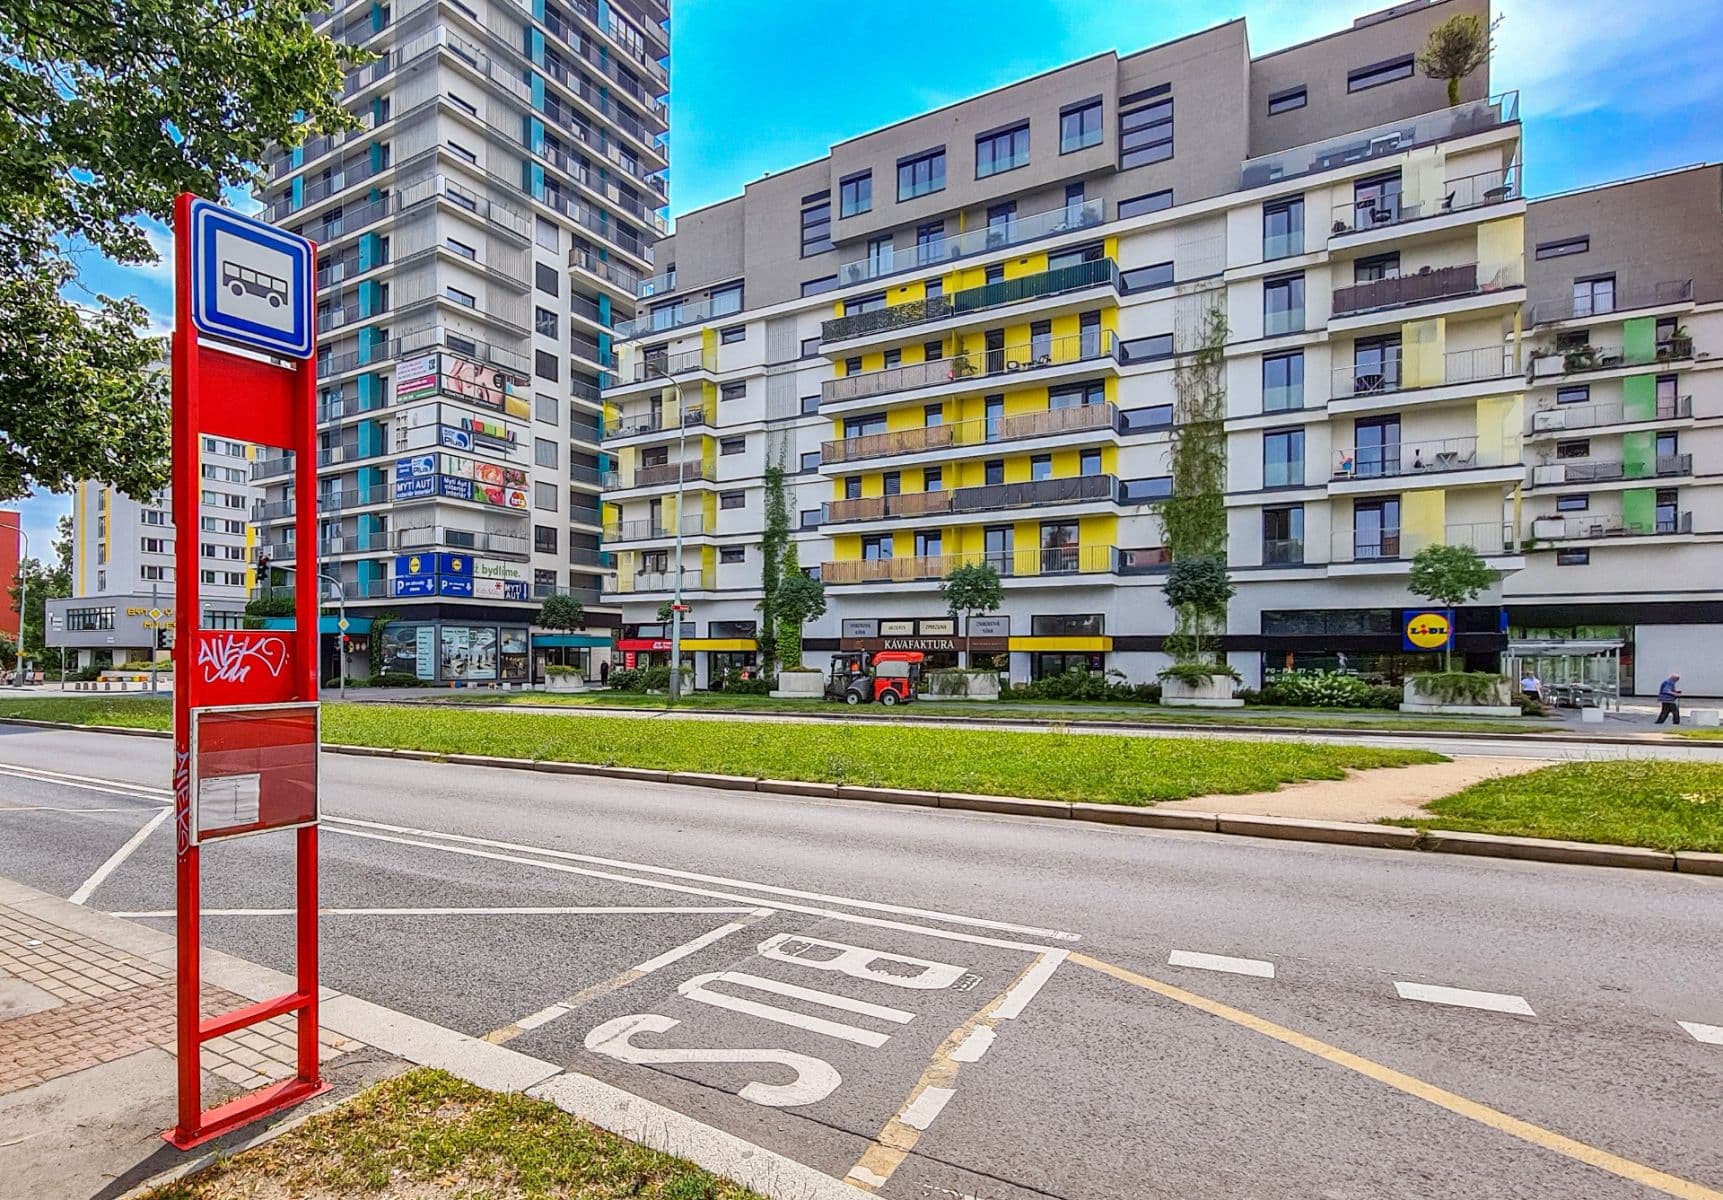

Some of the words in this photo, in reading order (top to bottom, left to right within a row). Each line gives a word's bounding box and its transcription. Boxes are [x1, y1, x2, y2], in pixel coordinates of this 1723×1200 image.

[415, 478, 431, 489] AUT
[397, 580, 404, 594] P
[442, 580, 448, 590] P
[884, 638, 954, 650] KÁVAFAKTURA
[584, 933, 970, 1107] BUS
